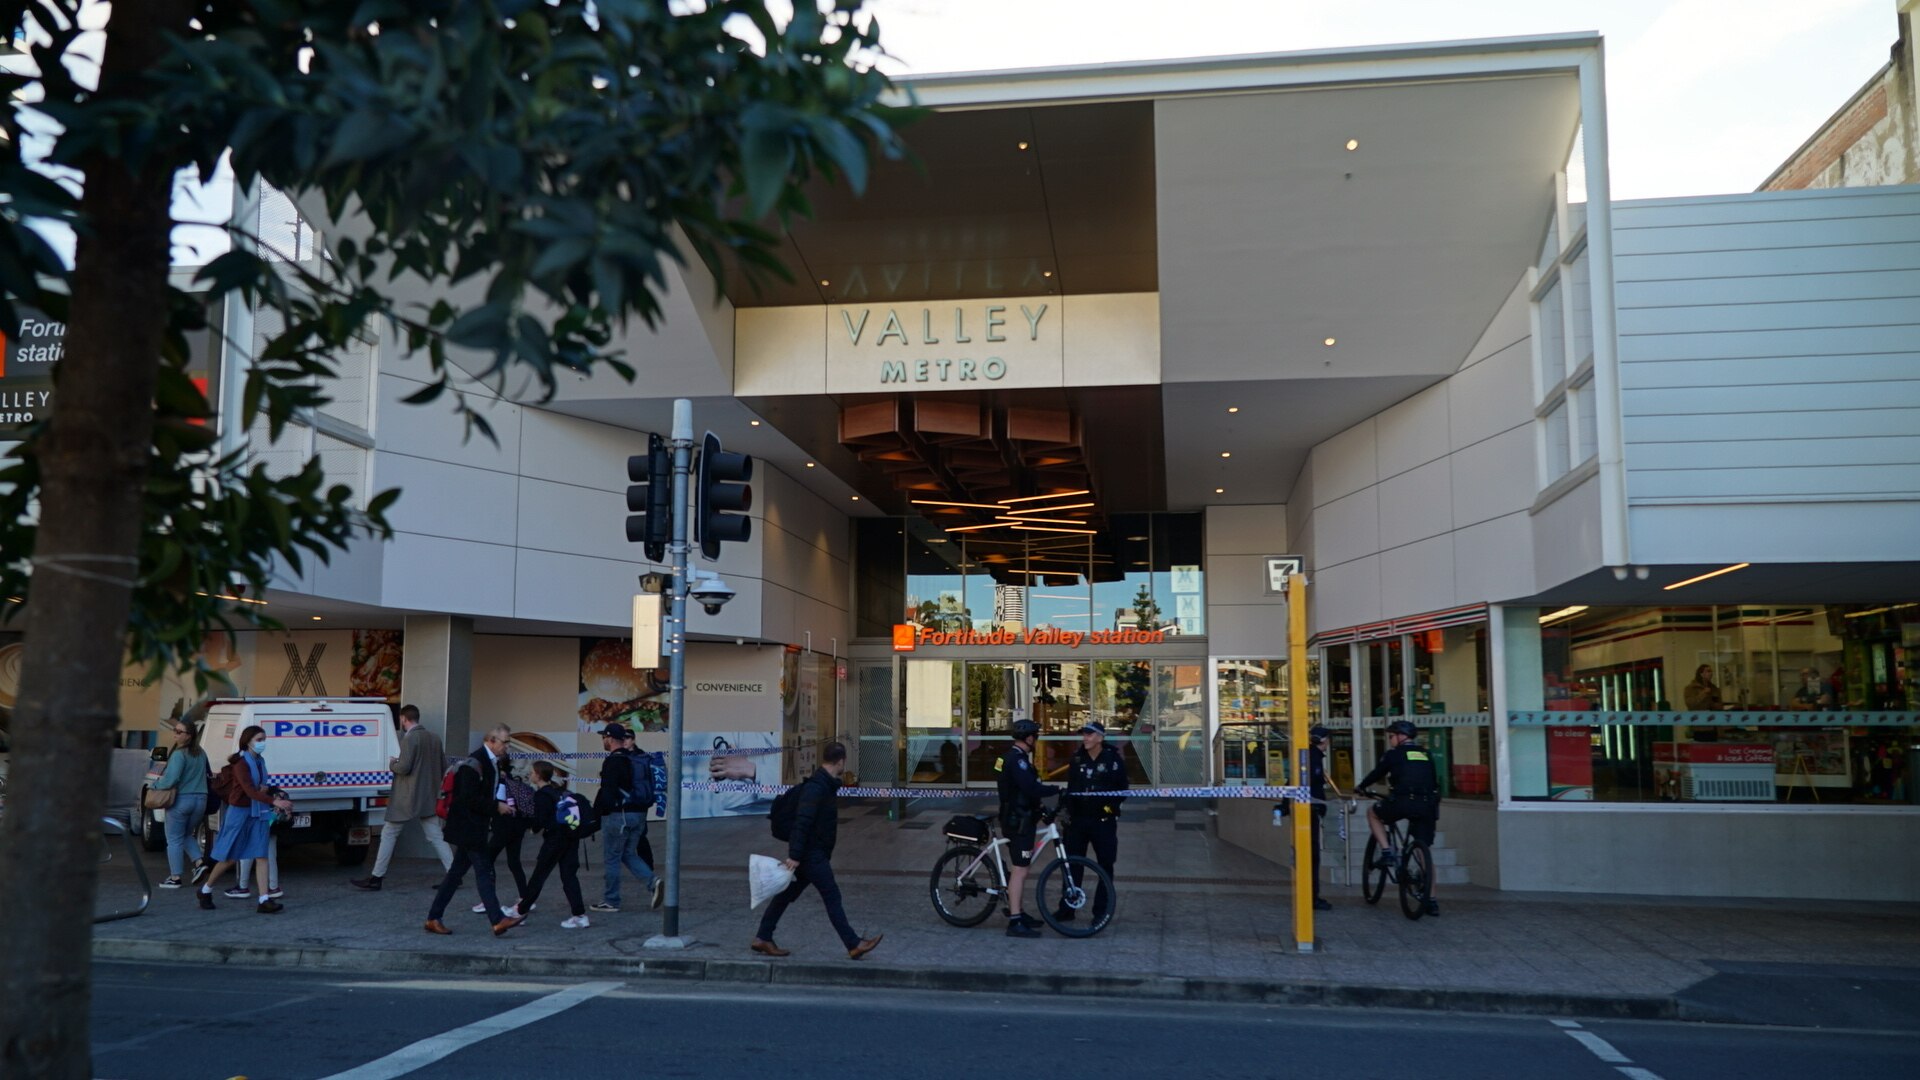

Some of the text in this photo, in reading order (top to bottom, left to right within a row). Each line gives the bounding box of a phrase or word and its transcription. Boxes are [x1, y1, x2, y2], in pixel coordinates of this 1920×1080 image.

[842, 304, 1047, 346] VALLEY
[881, 357, 1007, 383] METRO
[920, 627, 1165, 649] Fortitude Valley station
[696, 683, 763, 692] CONVENIENCE
[275, 721, 367, 737] Police
